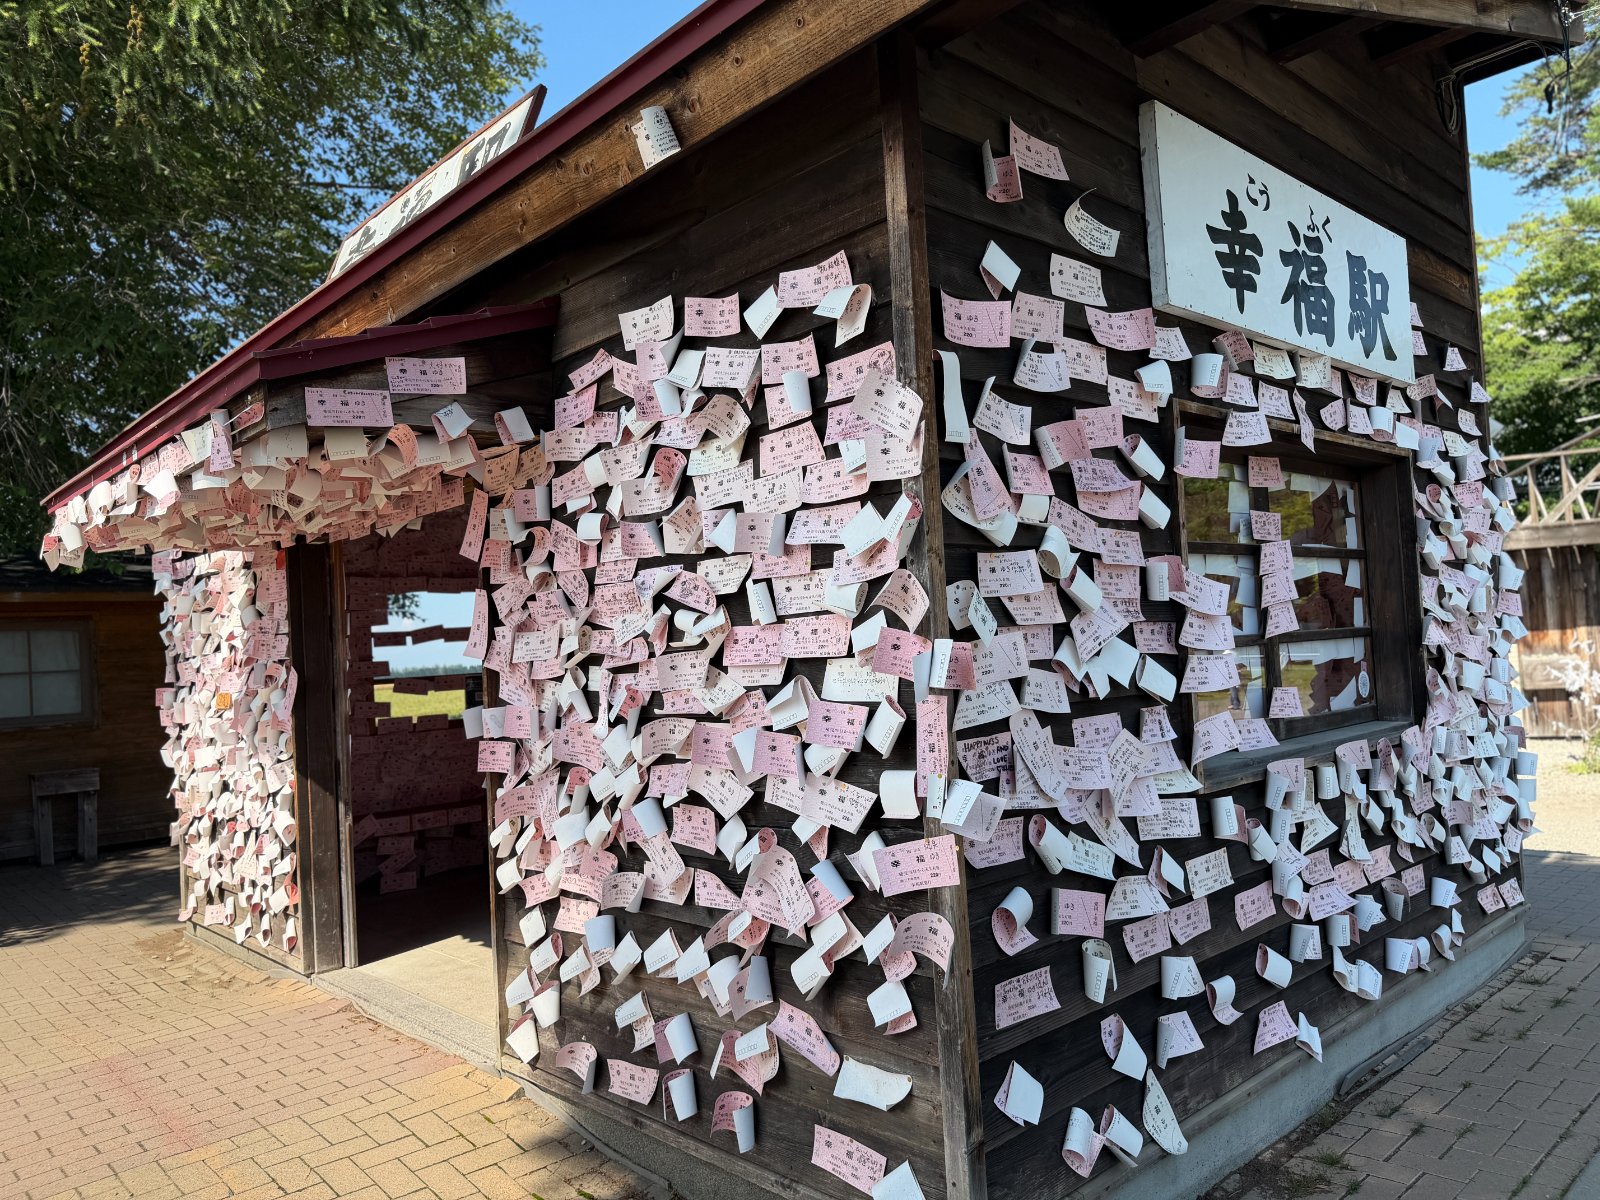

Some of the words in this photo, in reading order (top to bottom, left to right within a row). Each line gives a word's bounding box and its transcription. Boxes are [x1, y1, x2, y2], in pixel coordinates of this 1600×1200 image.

[1246, 173, 1271, 212] こう
[1306, 204, 1333, 243] ふく
[1205, 188, 1398, 362] 幸福駅
